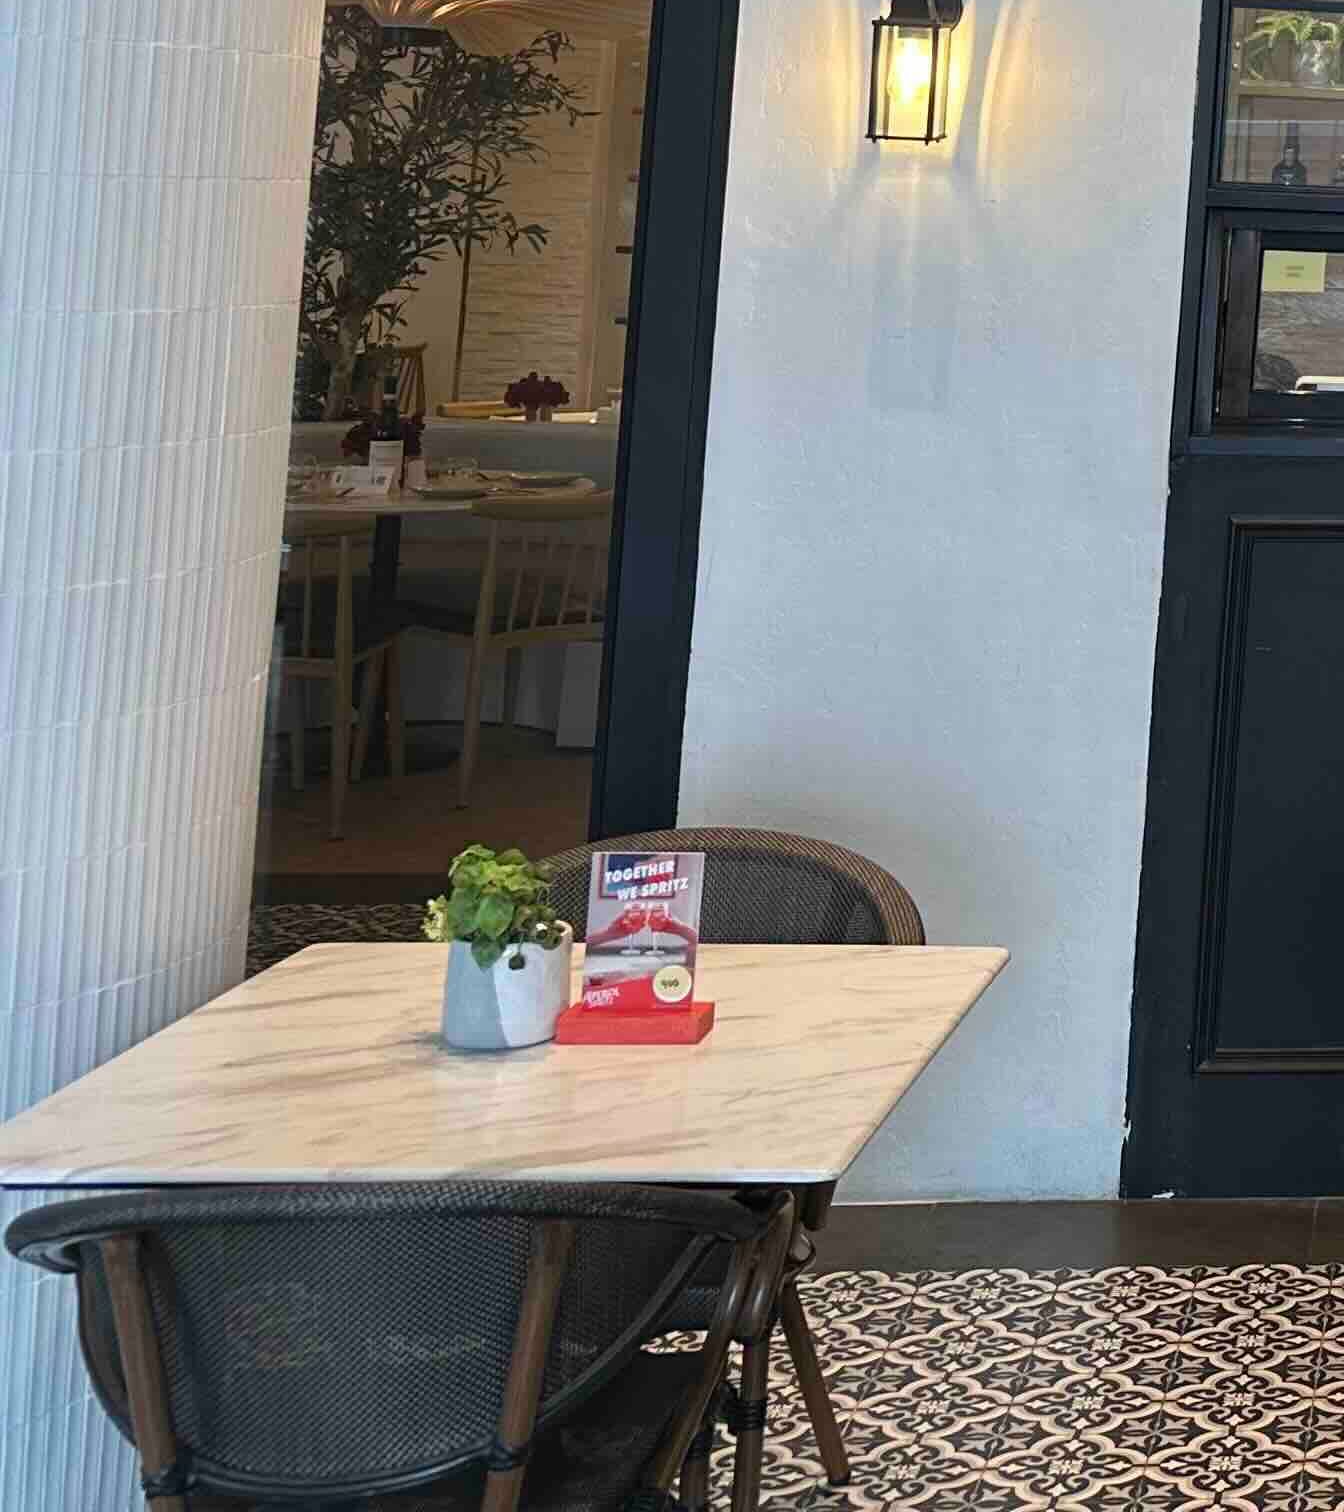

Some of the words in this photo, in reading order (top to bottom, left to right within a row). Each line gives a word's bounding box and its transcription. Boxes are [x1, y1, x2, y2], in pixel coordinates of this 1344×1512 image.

[605, 860, 675, 884] TOGETHER
[617, 885, 638, 900] WE
[641, 877, 688, 897] SPRITZ
